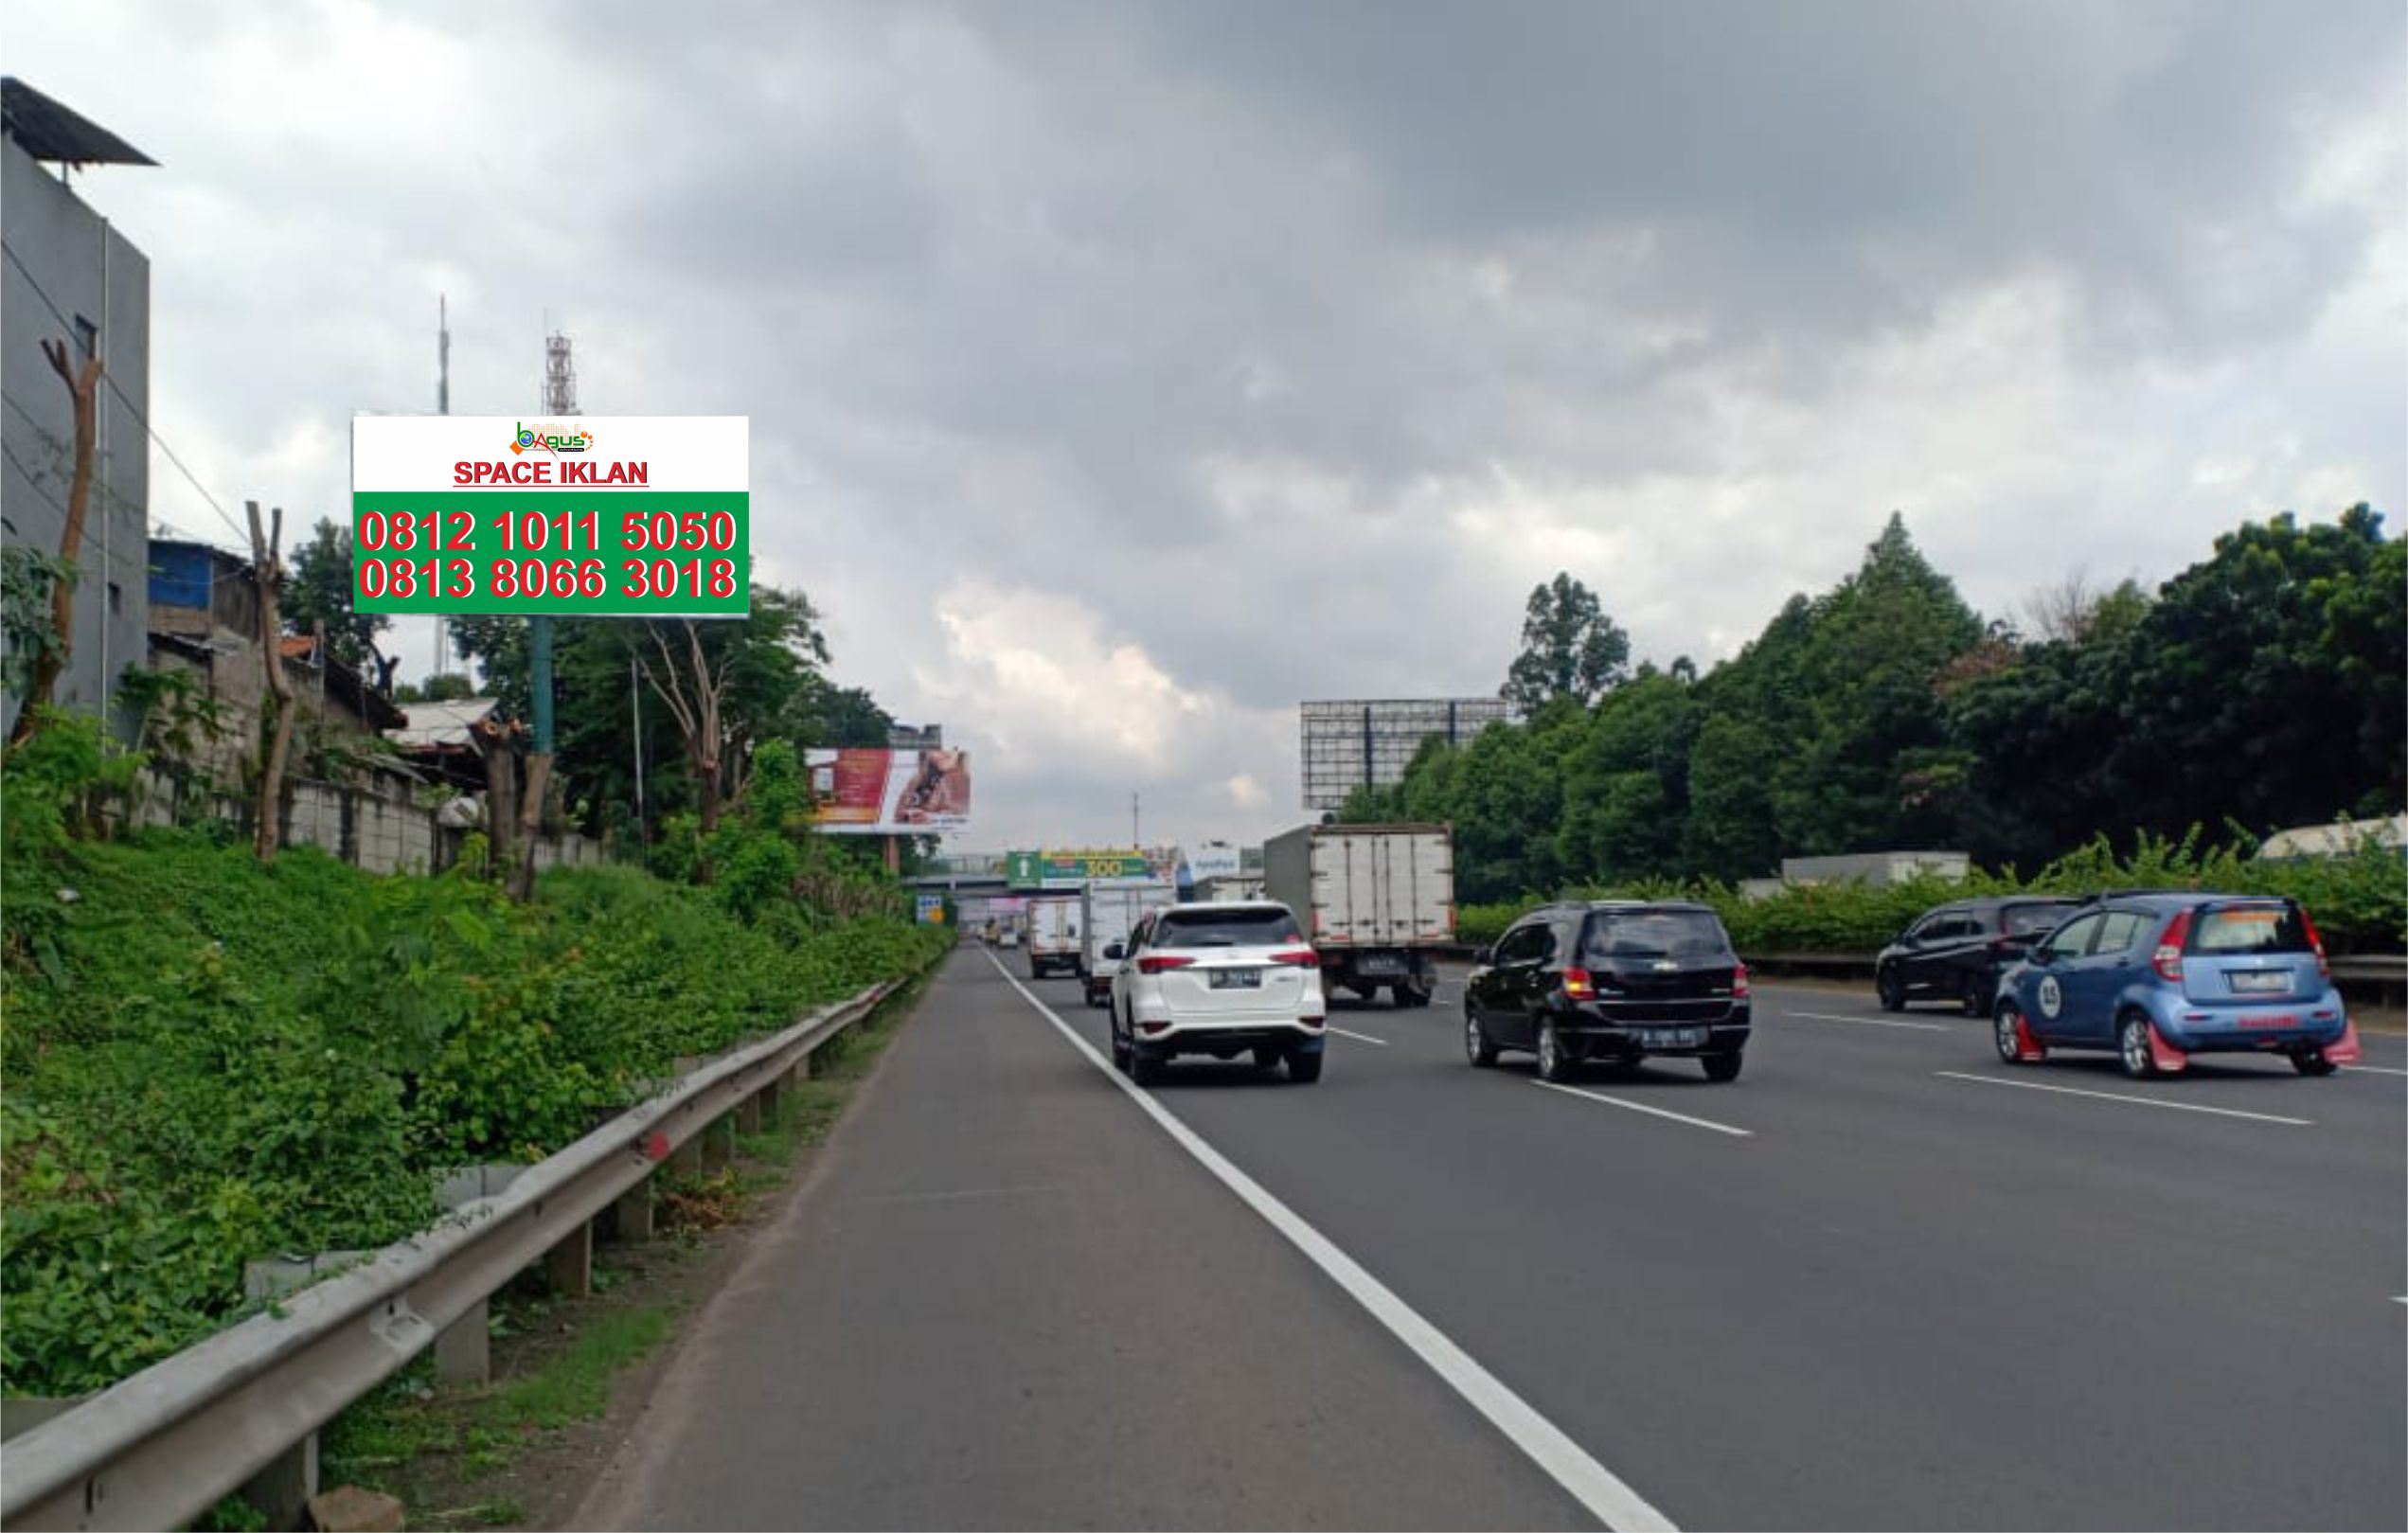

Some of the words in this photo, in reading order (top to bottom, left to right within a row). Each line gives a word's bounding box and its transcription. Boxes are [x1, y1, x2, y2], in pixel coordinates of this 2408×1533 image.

[454, 461, 551, 485] SPACE
[560, 461, 648, 485] IKLAN
[359, 510, 476, 551] 0812
[492, 510, 598, 551] 1011
[620, 510, 737, 551] 5050
[359, 558, 475, 598] 0813
[490, 558, 607, 598] 8066
[620, 558, 737, 598] 3018
